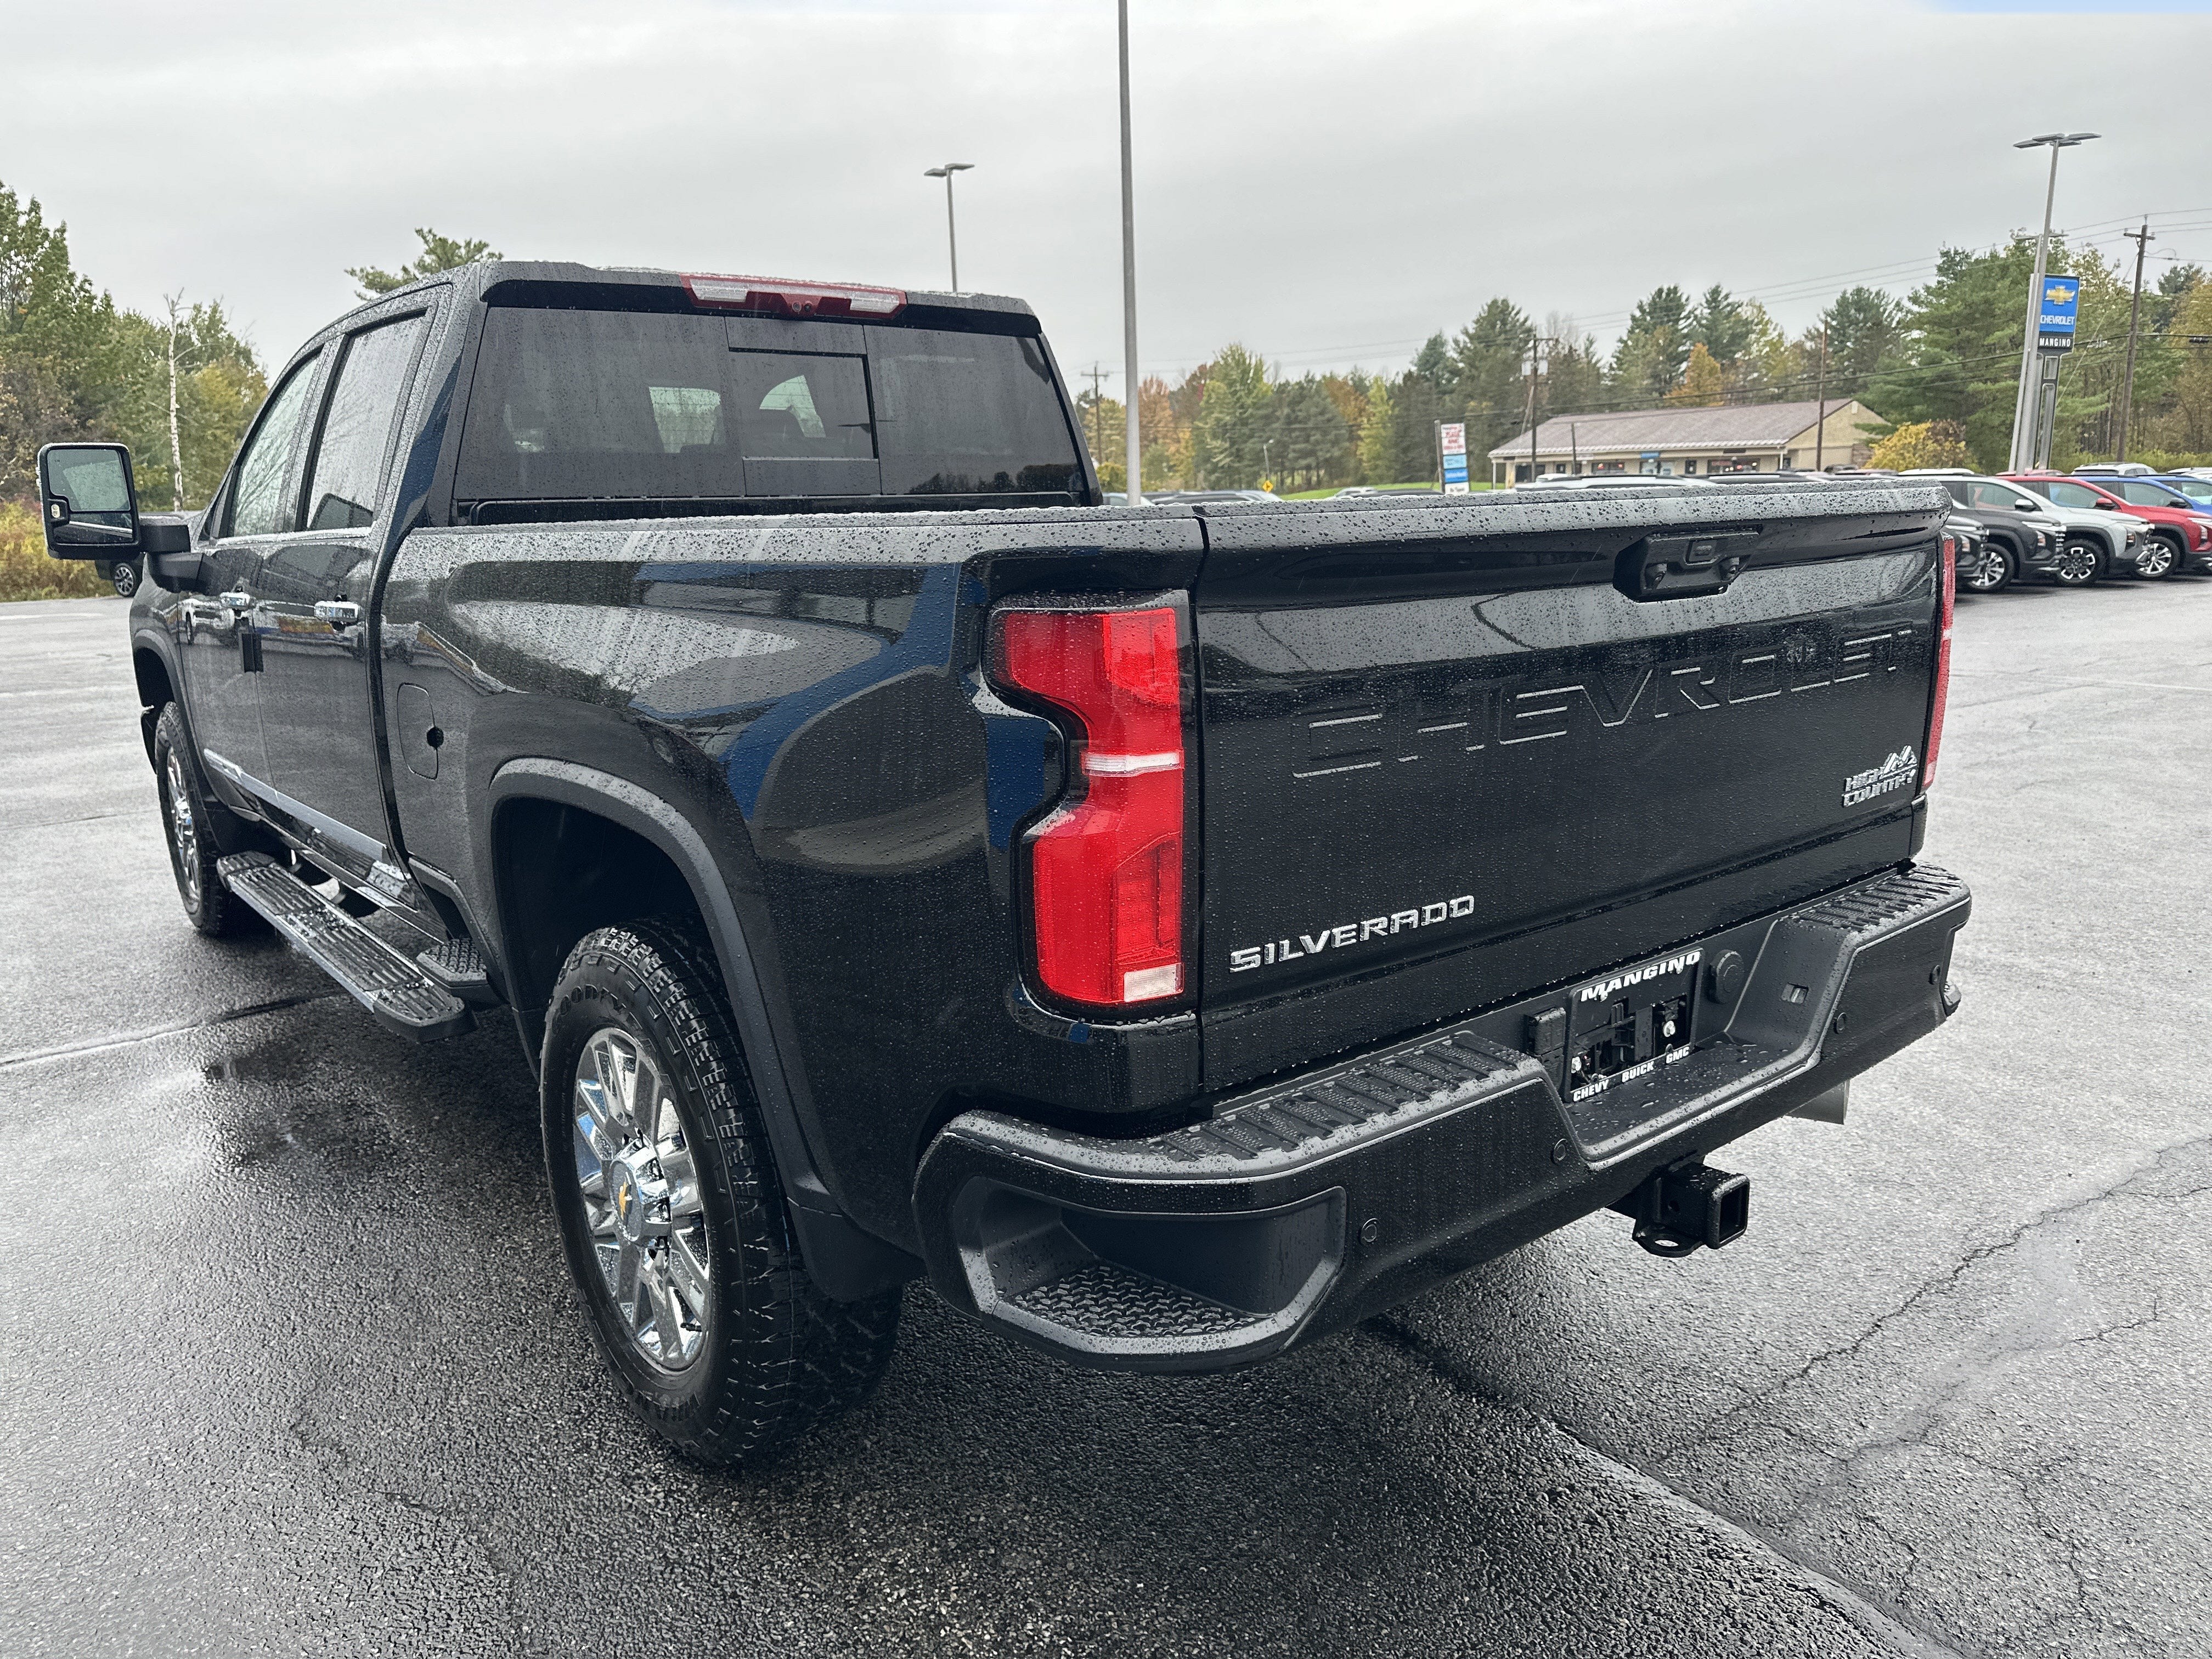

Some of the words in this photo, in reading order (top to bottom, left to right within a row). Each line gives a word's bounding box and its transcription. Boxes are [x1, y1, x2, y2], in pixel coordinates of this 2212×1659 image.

[2040, 315, 2075, 325] CHEVROLET
[2039, 338, 2071, 347] MANGINO
[1292, 625, 1914, 778] CHEVROLET
[1842, 769, 1916, 807] COUNTRY
[1844, 766, 1886, 792] HIGH
[1229, 895, 1475, 973] SILVERADO
[1581, 951, 1701, 1002] MANGINO
[1573, 1079, 1609, 1102] CHEVY
[1622, 1061, 1655, 1082] BUICK
[1666, 1046, 1690, 1064] GMC
